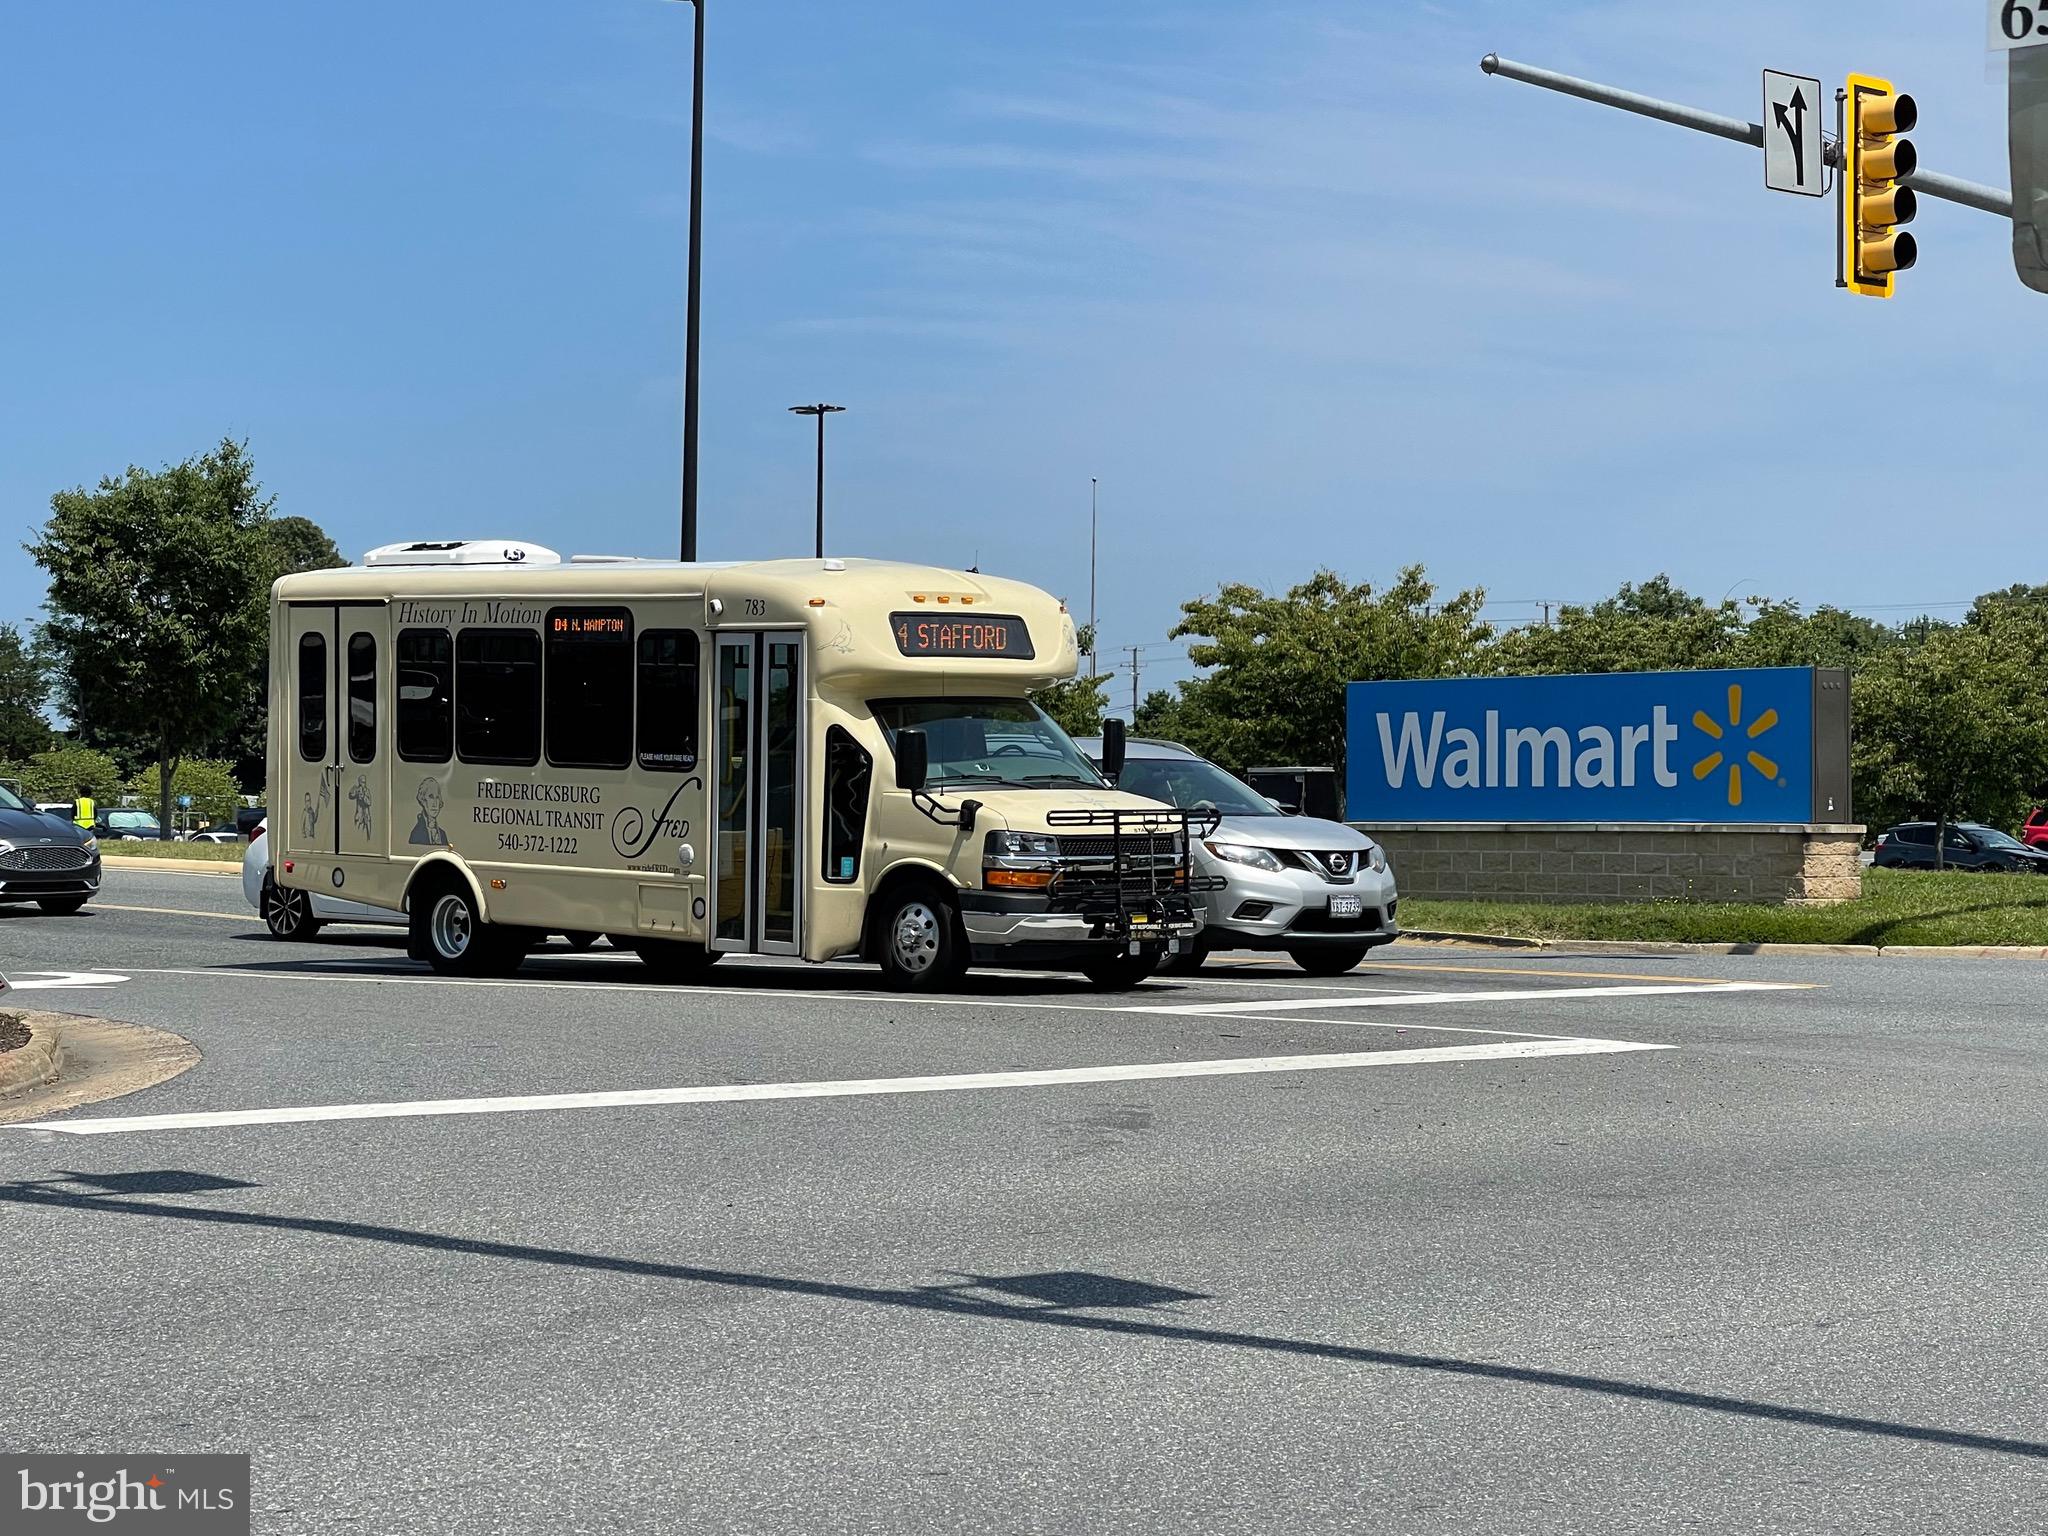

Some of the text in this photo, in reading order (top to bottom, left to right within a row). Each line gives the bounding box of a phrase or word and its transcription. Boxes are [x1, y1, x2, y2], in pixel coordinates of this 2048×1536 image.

[399, 602, 542, 627] History In Motion
[745, 598, 765, 616] 783
[583, 618, 624, 632] HAMPTON
[898, 623, 1007, 650] 4 STAFFORD
[1375, 705, 1678, 790] Walmart
[477, 781, 601, 804] FREDERICKSBURG
[473, 806, 605, 830] REGIONAL TRANSIT
[498, 833, 578, 855] 540-372-1222
